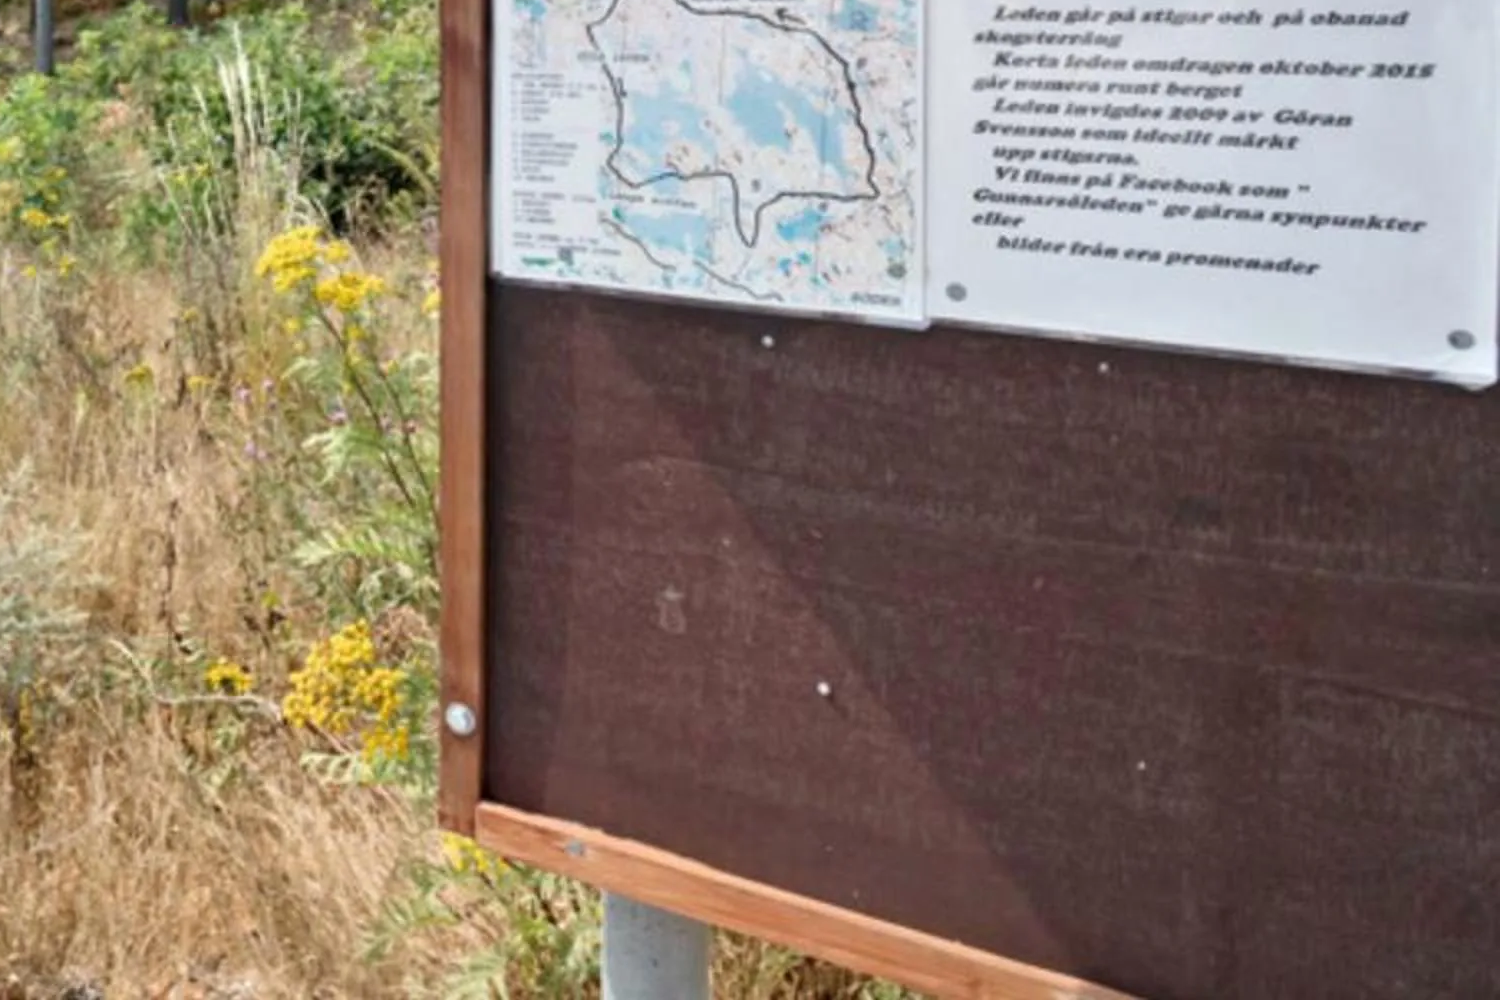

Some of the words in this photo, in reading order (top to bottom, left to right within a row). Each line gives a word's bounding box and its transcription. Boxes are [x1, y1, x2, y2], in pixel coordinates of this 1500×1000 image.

[992, 5, 1060, 23] Leden
[1064, 8, 1105, 25] går
[1108, 8, 1136, 26] på
[1141, 8, 1213, 27] stigar
[1218, 8, 1262, 25] och
[1273, 10, 1304, 28] på
[1311, 9, 1409, 27] obanad
[992, 52, 1060, 70] Korta
[1065, 54, 1128, 71] leden
[1133, 57, 1254, 76] omdragen
[1260, 60, 1364, 78] oktober
[1369, 63, 1436, 79] 2015
[972, 76, 1008, 93] går
[1012, 78, 1100, 93] numera
[1107, 80, 1160, 96] runt
[1166, 82, 1244, 100] berget
[992, 100, 1060, 115] Leden
[1064, 101, 1164, 120] invigdes
[1234, 110, 1263, 124] av
[1273, 109, 1354, 128] Göran
[973, 120, 1076, 137] Svensson
[1081, 127, 1128, 141] som
[1218, 131, 1299, 149] märkt
[992, 147, 1036, 163] upp
[994, 167, 1020, 182] Vi
[1024, 168, 1081, 186] finns
[1086, 170, 1115, 188] på
[1119, 175, 1234, 195] Facebook
[1238, 184, 1291, 199] som
[972, 212, 1025, 227] eller
[1164, 202, 1191, 219] ge
[1194, 203, 1265, 223] gärna
[1271, 210, 1427, 233] synpunkter
[997, 236, 1066, 255] bilder
[1070, 240, 1119, 258] från
[1124, 247, 1161, 261] era
[1166, 249, 1320, 275] promenader
